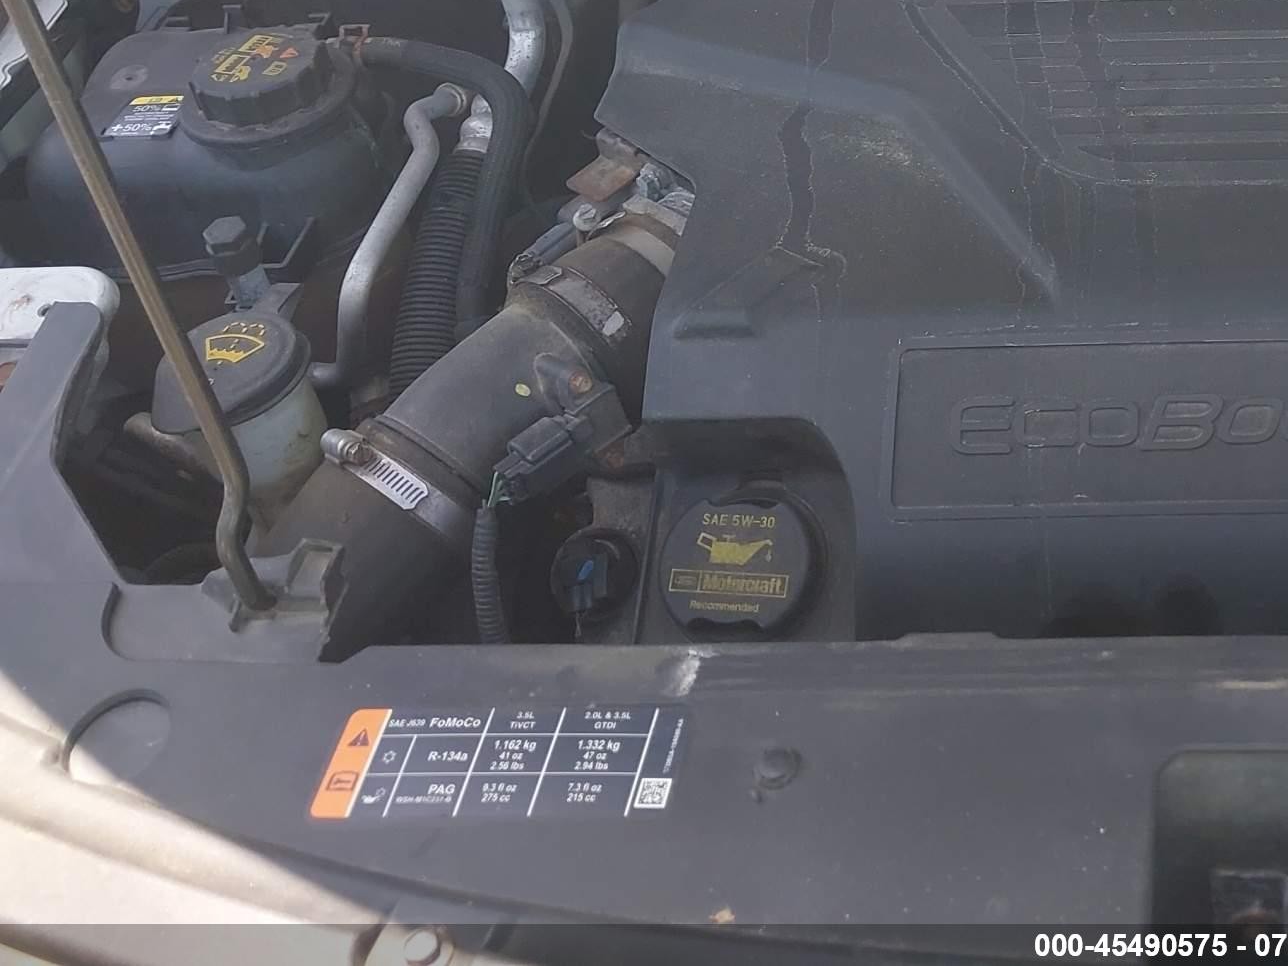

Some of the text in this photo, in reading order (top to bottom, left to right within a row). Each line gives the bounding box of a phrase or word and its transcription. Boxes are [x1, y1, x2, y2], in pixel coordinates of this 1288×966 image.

[702, 513, 776, 529] SAE 5W-30
[702, 574, 784, 594] Motorcraft
[689, 600, 760, 612] Recommended
[584, 711, 631, 720] 2.0L & 3.5L
[429, 716, 481, 728] FoMoCo
[594, 721, 617, 729] GTDI
[494, 739, 537, 753] 1.162 kg
[578, 739, 621, 753] 1.332 kg
[427, 750, 469, 762] R-134a
[499, 751, 524, 760] 41 oz
[582, 751, 607, 760] 47 oz
[510, 761, 525, 770] lbs
[573, 761, 609, 771] 2.94 lbs
[427, 783, 456, 795] PAG
[505, 784, 518, 792] oz
[567, 782, 582, 792] 7.3
[590, 784, 602, 792] oz
[481, 793, 511, 803] 275 cc
[566, 793, 596, 803] 215 cc
